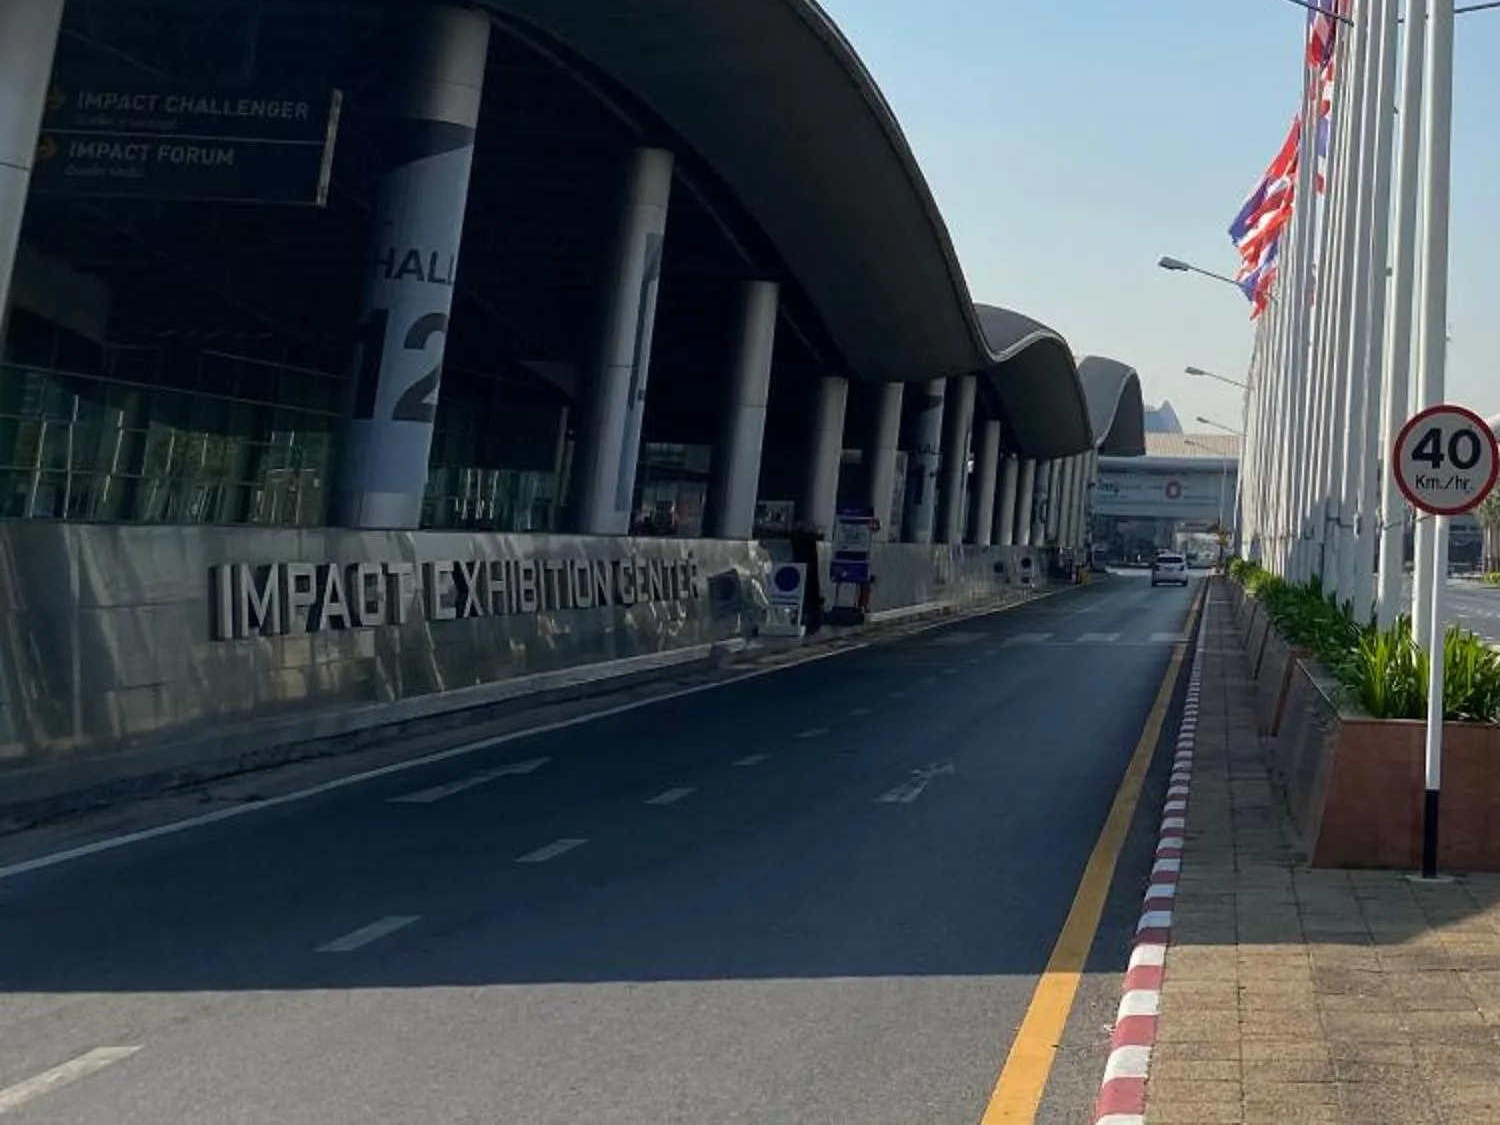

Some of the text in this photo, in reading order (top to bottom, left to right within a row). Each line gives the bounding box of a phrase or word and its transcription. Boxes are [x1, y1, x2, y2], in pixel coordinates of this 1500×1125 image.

[77, 90, 311, 120] IMPACT CHALLENGER
[68, 140, 236, 166] IMPACT FORUM
[352, 309, 447, 421] 12
[1411, 427, 1481, 469] 40
[210, 555, 701, 641] IMPACT EXHIBITION CENTER
